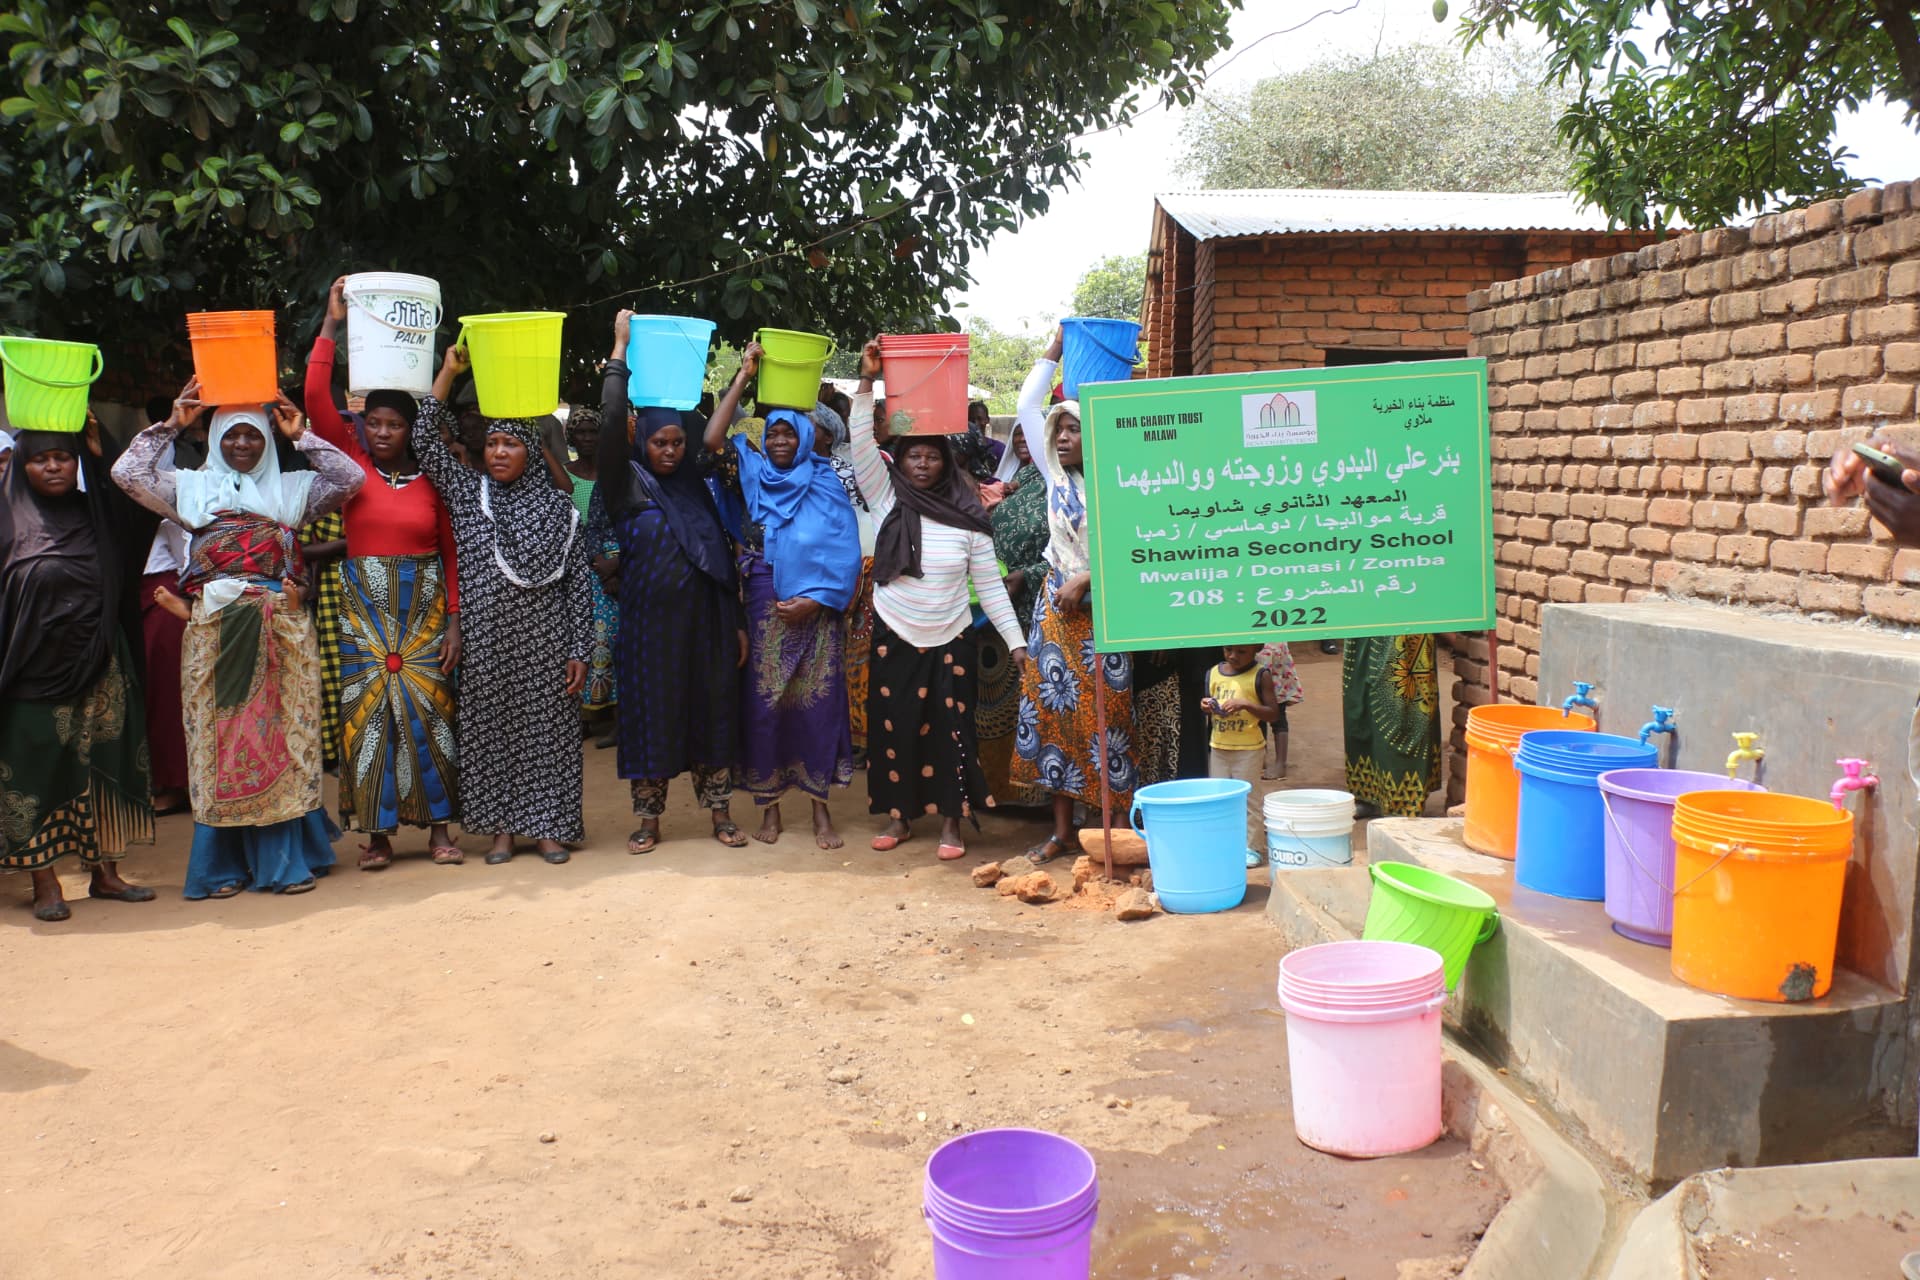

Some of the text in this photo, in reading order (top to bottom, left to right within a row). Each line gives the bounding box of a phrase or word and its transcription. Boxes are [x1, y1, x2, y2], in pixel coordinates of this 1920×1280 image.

[394, 331, 427, 345] PALM
[1373, 395, 1455, 414] منظمة بناء الخيرية
[1116, 412, 1203, 429] BENA CHARITY TRUST
[1404, 413, 1432, 430] ملاوي
[1144, 429, 1177, 442] MALAWI
[1116, 444, 1460, 496] بئر علي البدوي وزوجته ووالديهما
[1168, 489, 1407, 518] المعهد الثانوي شاويما
[1315, 511, 1392, 530] مواليجا
[1400, 504, 1447, 525] قرية
[1204, 518, 1291, 540] دوماسي
[1131, 530, 1453, 564] Shawima Secondry School
[1140, 567, 1229, 584] Mwalija
[1251, 560, 1341, 577] Domasi
[1362, 555, 1446, 571] Zomba
[1256, 579, 1364, 606] المشروع
[1375, 575, 1417, 598] رقم
[1169, 588, 1224, 608] 208
[1251, 606, 1328, 628] 2022
